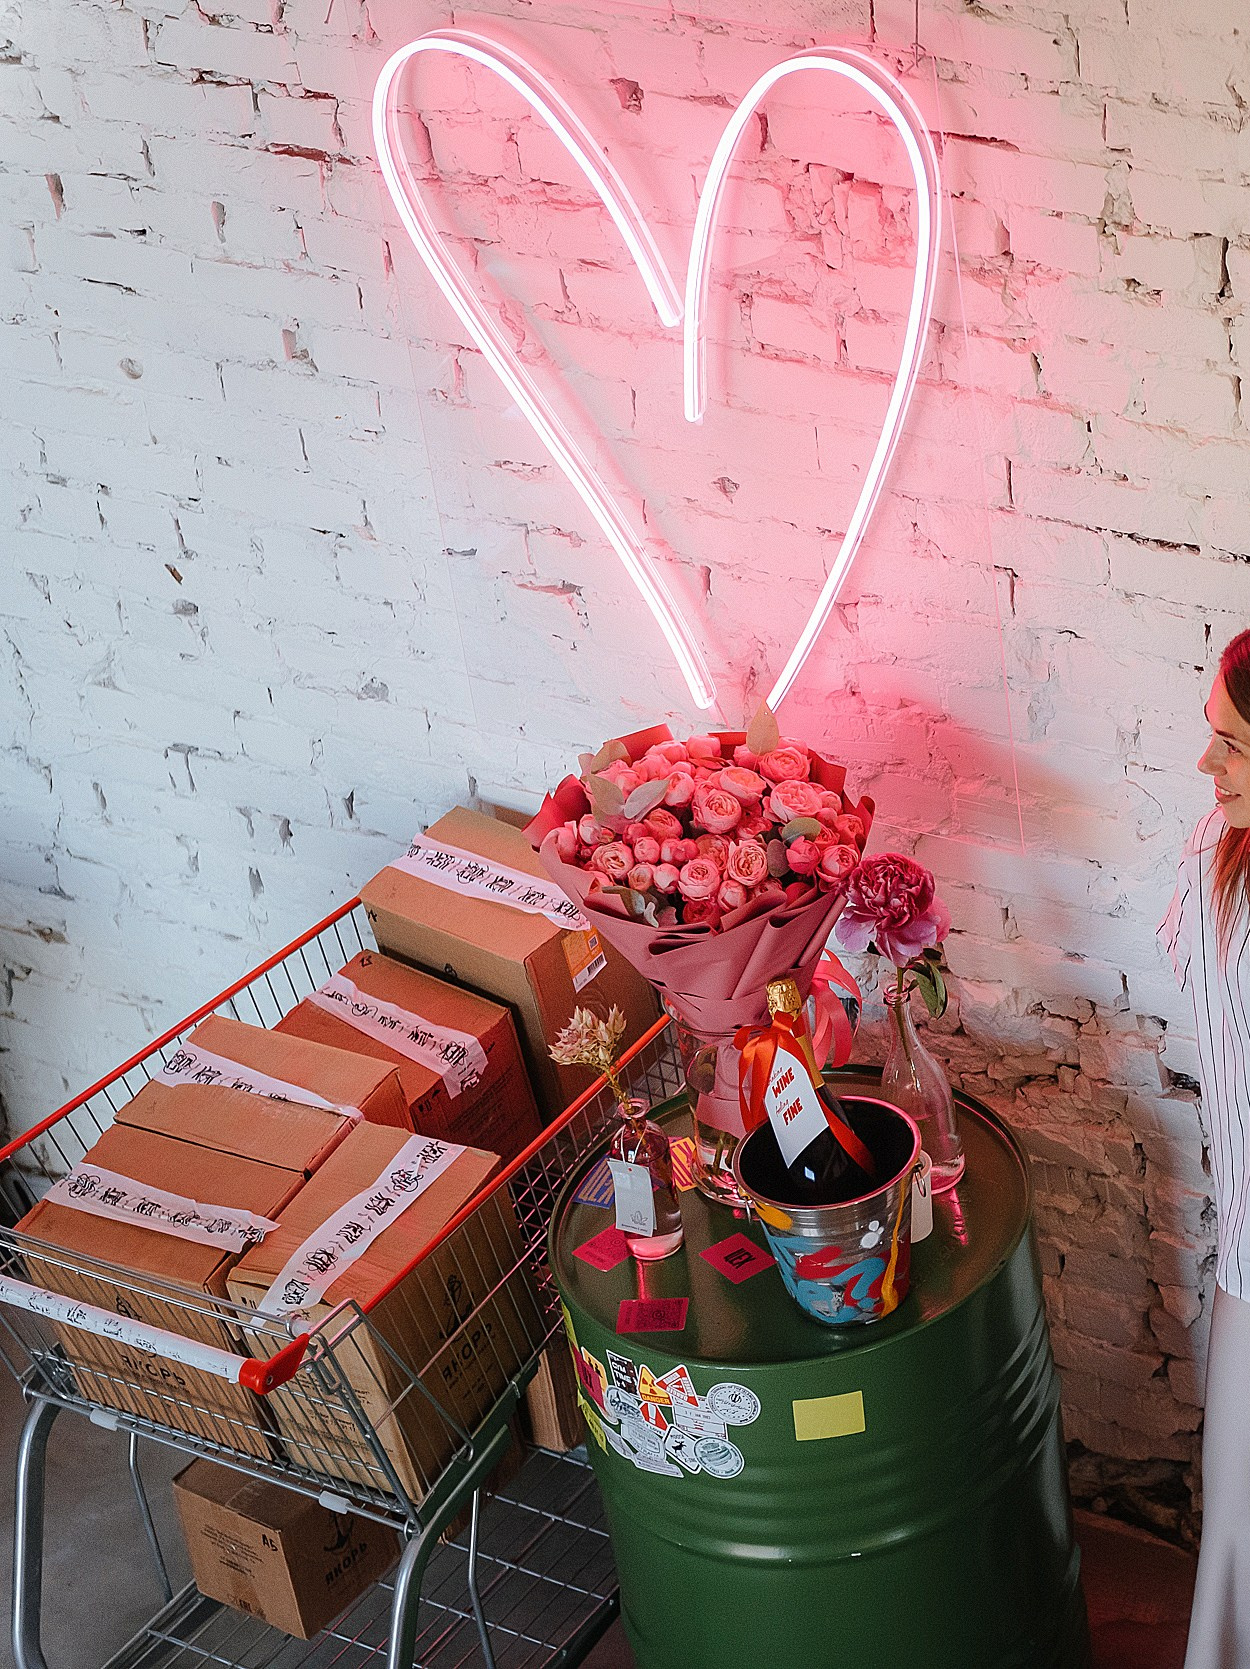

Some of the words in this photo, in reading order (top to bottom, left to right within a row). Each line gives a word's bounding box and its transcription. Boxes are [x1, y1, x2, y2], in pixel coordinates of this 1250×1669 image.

[771, 1066, 795, 1099] WINE
[782, 1096, 804, 1127] FINE
[723, 1247, 757, 1270] ЦЕХ
[641, 1394, 671, 1405] DANGER
[324, 1542, 368, 1586] ЯКОРЬ
